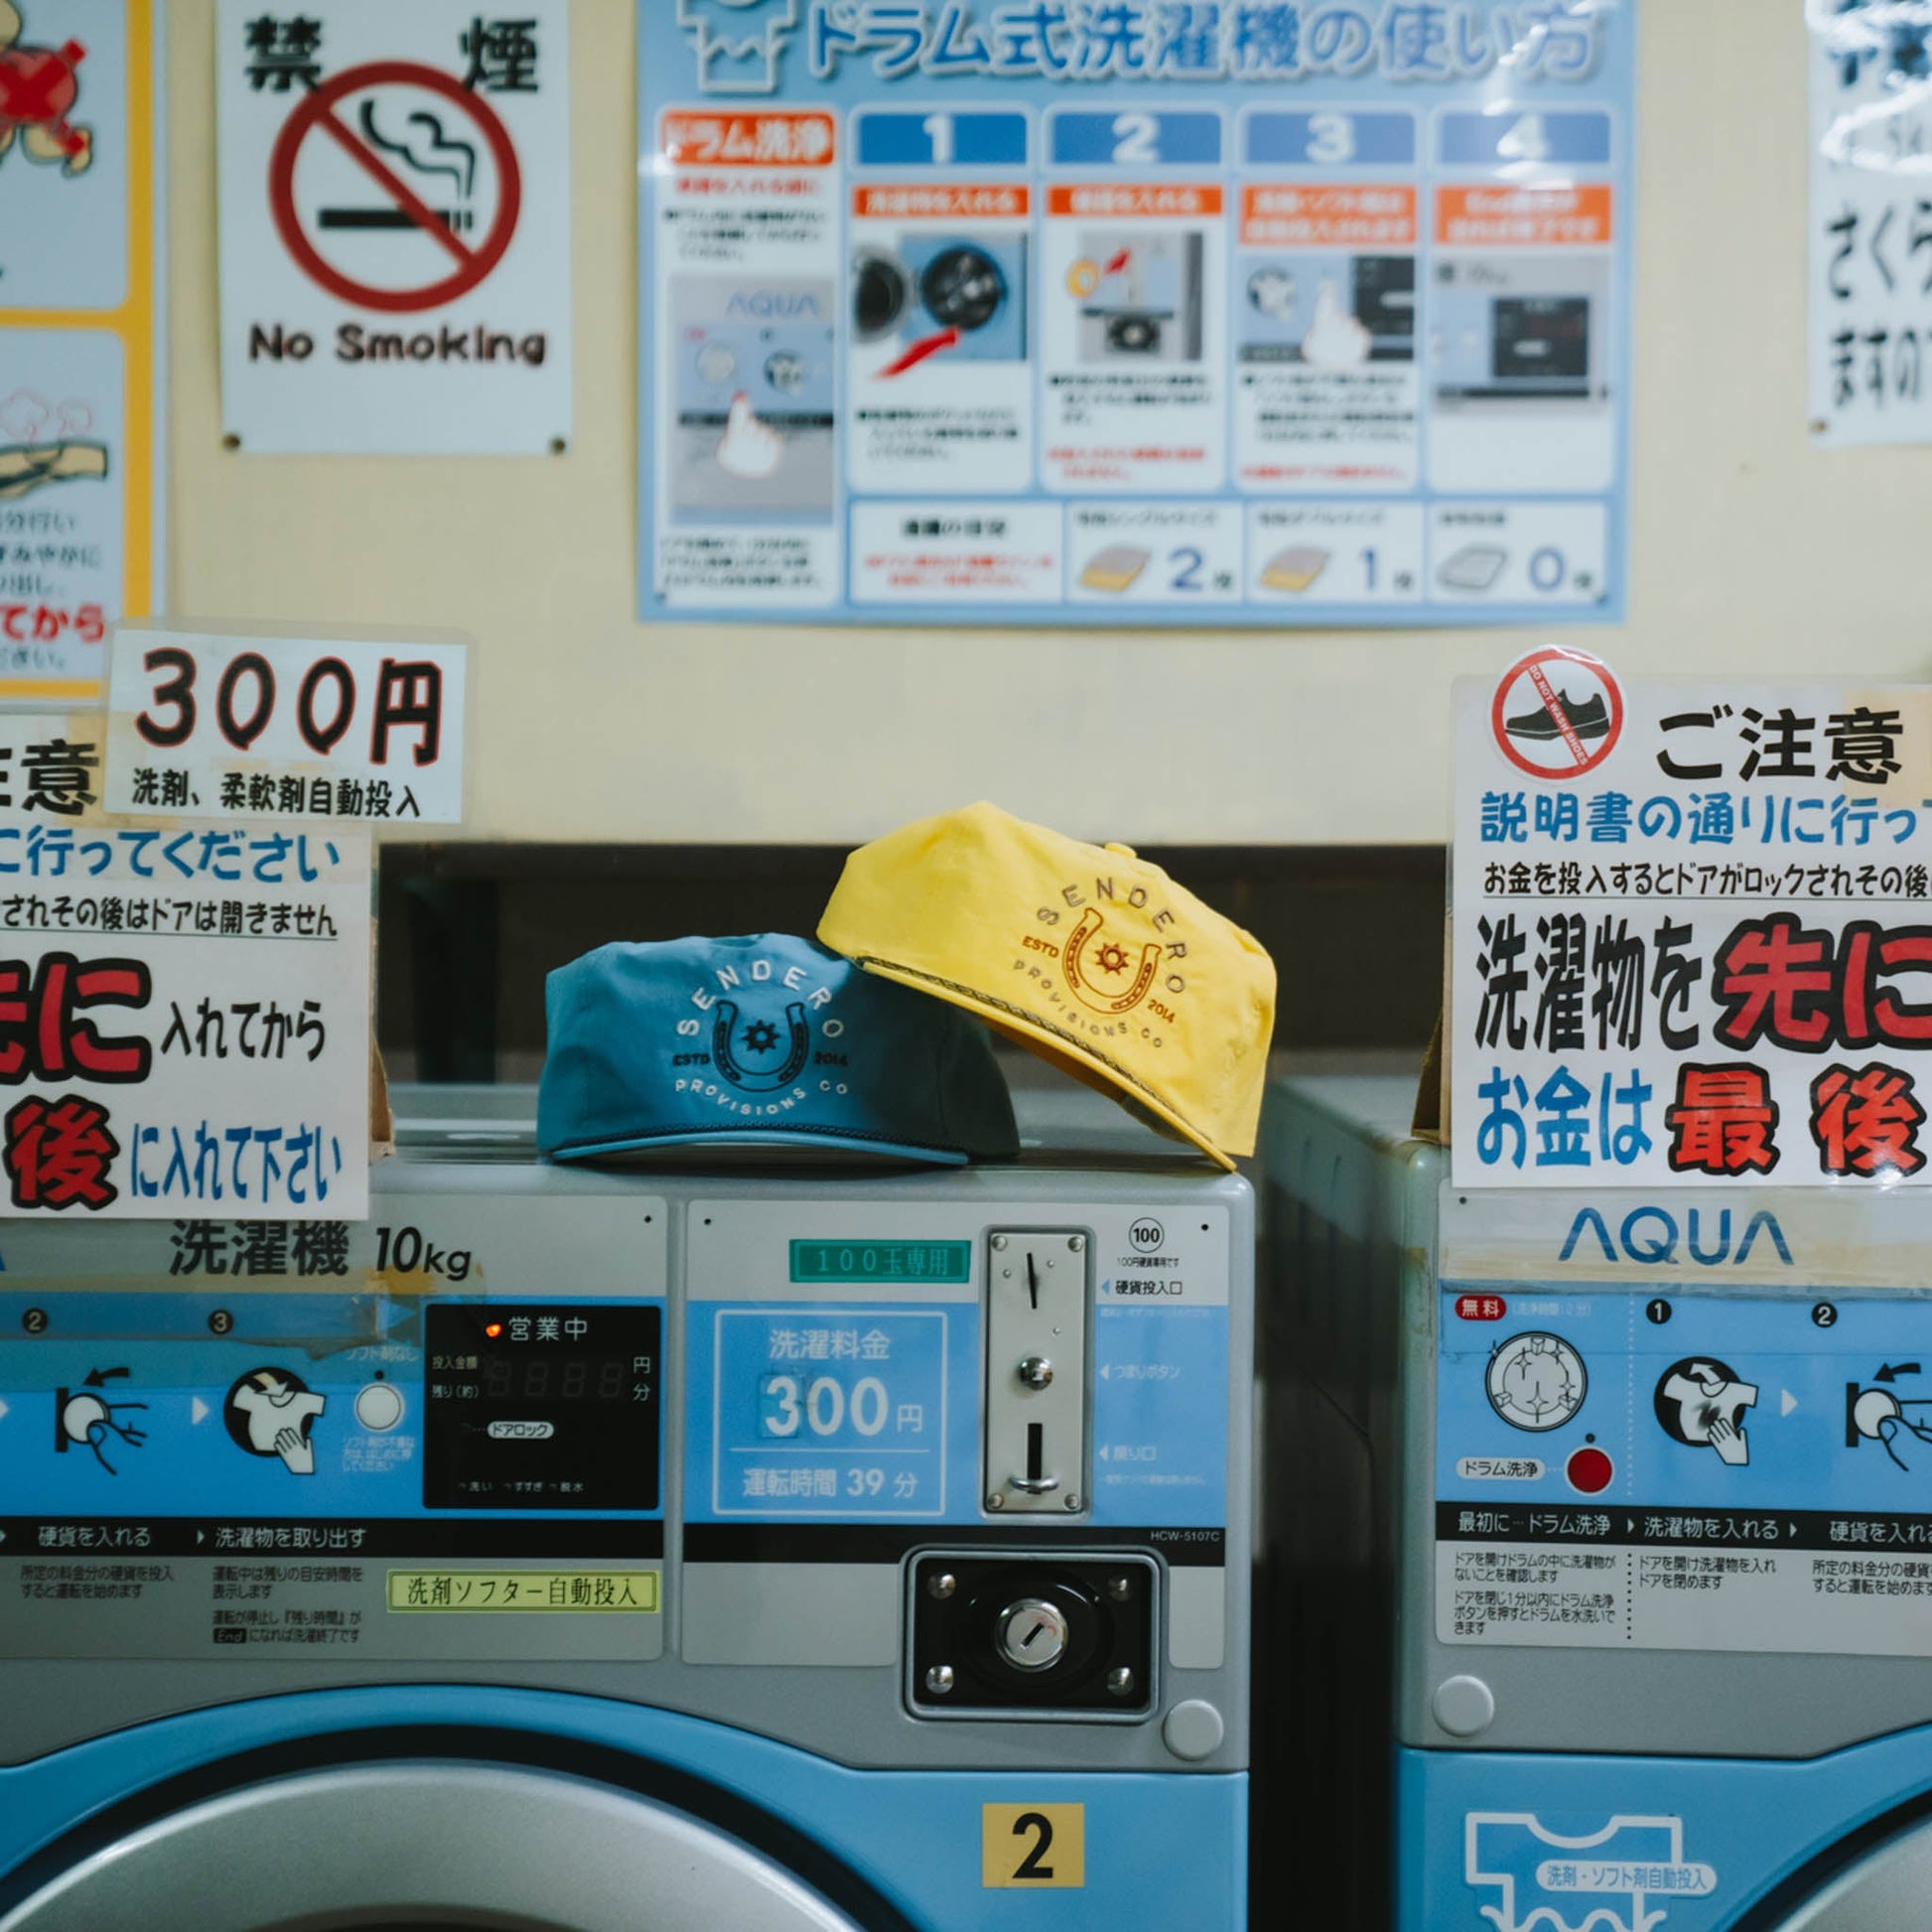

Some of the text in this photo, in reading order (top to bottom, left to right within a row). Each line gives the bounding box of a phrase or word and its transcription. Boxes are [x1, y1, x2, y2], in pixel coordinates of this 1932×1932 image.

[809, 0, 1602, 81] ドラム式洗濯機の使い方
[923, 116, 953, 162] 1
[1112, 114, 1161, 163] 2
[1307, 114, 1356, 163] 3
[1496, 115, 1551, 162] 4
[248, 324, 547, 366] No Smoking
[0, 547, 100, 569] みやかに
[1169, 548, 1204, 590] 2
[1362, 549, 1376, 590] 1
[1529, 549, 1564, 591] 0
[134, 646, 443, 767] 300円
[1656, 704, 1903, 784] ご注意
[0, 739, 99, 815] 意
[131, 767, 421, 818] 洗剤、柔軟剤自動投入
[1480, 791, 1932, 846] 説明書の通りに行っ
[1484, 861, 1929, 898] お金を投入するとドアがロックされその後
[2, 893, 338, 936] されその後はドアは開きません
[1036, 877, 1187, 994] SENDERO
[1022, 935, 1175, 1024] ESTD 2014
[676, 960, 844, 1037] SENDERO
[1014, 959, 1162, 1048] PROVISIONS CO
[672, 1053, 711, 1066] ESTD
[675, 1079, 848, 1116] PROVISIONS CO
[169, 1219, 472, 1282] 洗濯機 10kg
[1133, 1228, 1161, 1243] 100
[1558, 1205, 1794, 1265] AQUA
[1115, 1280, 1182, 1295] 硬貨投入口
[1461, 1300, 1499, 1316] 無料
[508, 1316, 588, 1342] 営業中
[769, 1328, 891, 1360] 洗濯料金
[632, 1356, 650, 1374] 円
[632, 1384, 651, 1401] 分
[493, 1424, 549, 1437] ドアロック
[1465, 1461, 1538, 1476] ドラム洗浄
[38, 1526, 150, 1547] 硬貨を入れる
[214, 1526, 366, 1549] 洗濯物を取り出す
[1150, 1531, 1220, 1542] HCW-5107C
[1644, 1517, 1778, 1539] 洗濯物を入れる
[1454, 1568, 1558, 1584] ないことを確認します
[1455, 1552, 1616, 1570] ドアを開けドラムの中に洗濯物が
[1639, 1556, 1776, 1573] ドアを開け洗濯物を入れ
[408, 1578, 637, 1605] 洗剤ソフター自動投入
[1639, 1575, 1724, 1589] ドアを閉めます
[1454, 1606, 1615, 1624] ボタンを押すとドラムを水洗いで
[1454, 1621, 1486, 1635] きます
[1013, 1812, 1053, 1878] 2
[1547, 1865, 1707, 1890] 洗剤・ソフト剤自動投入
